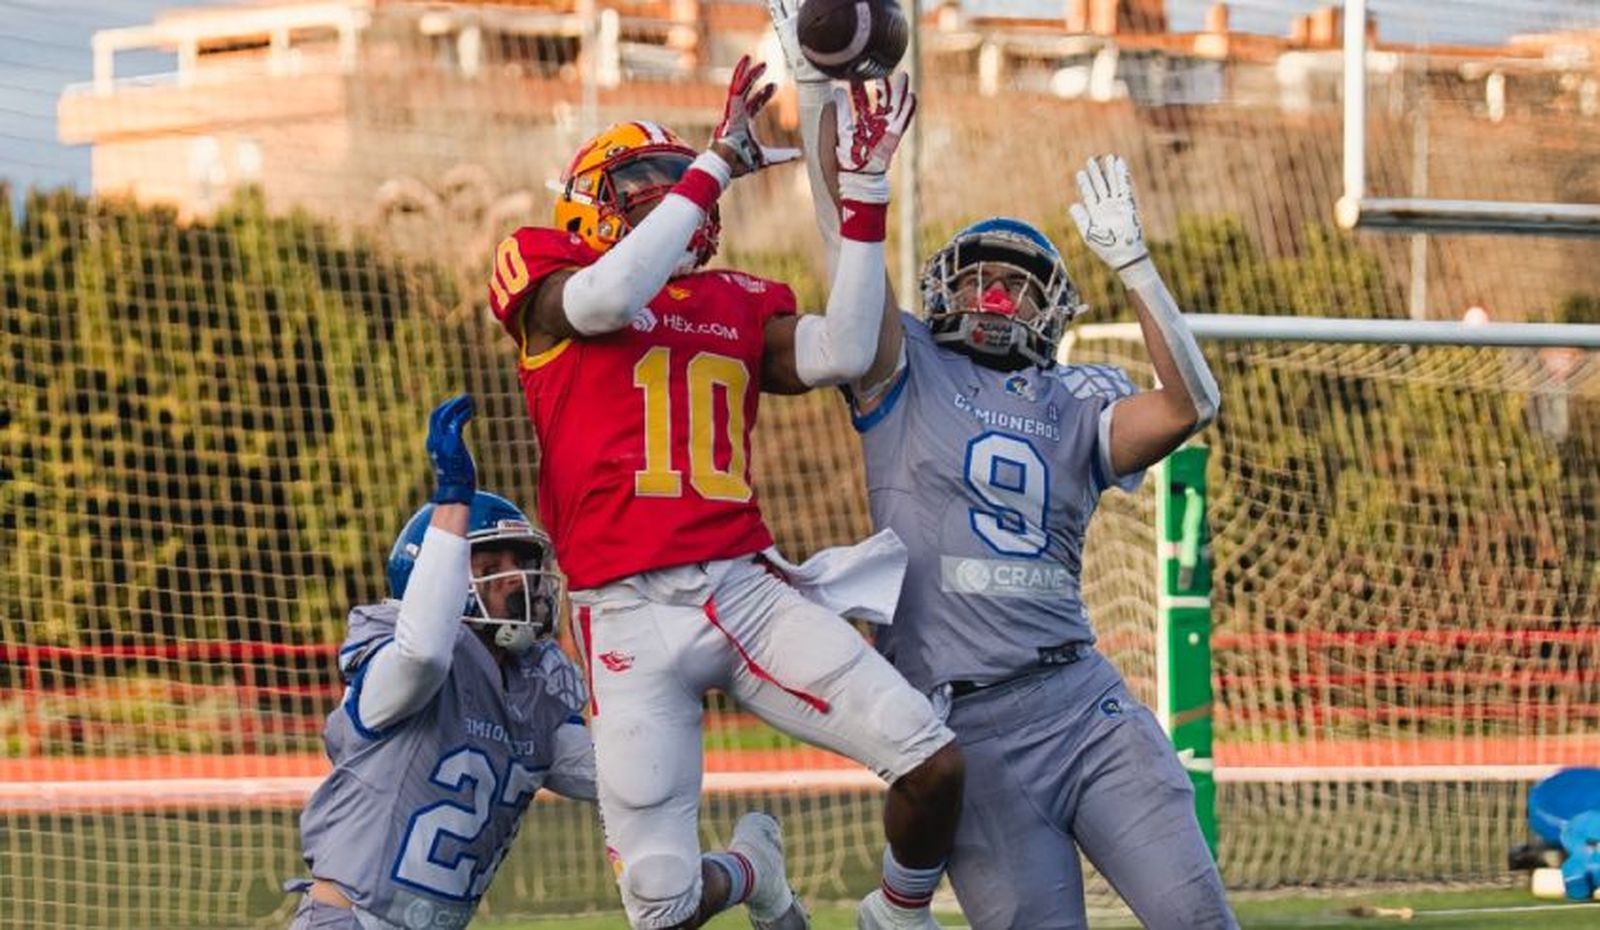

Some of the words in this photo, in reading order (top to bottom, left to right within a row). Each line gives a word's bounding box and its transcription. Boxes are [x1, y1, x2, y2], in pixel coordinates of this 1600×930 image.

[490, 236, 530, 310] 10
[663, 313, 739, 341] HEX.COM
[633, 345, 753, 503] 10
[954, 393, 1061, 441] CMIONEROS
[963, 429, 1051, 559] 9
[993, 565, 1066, 588] CRANE
